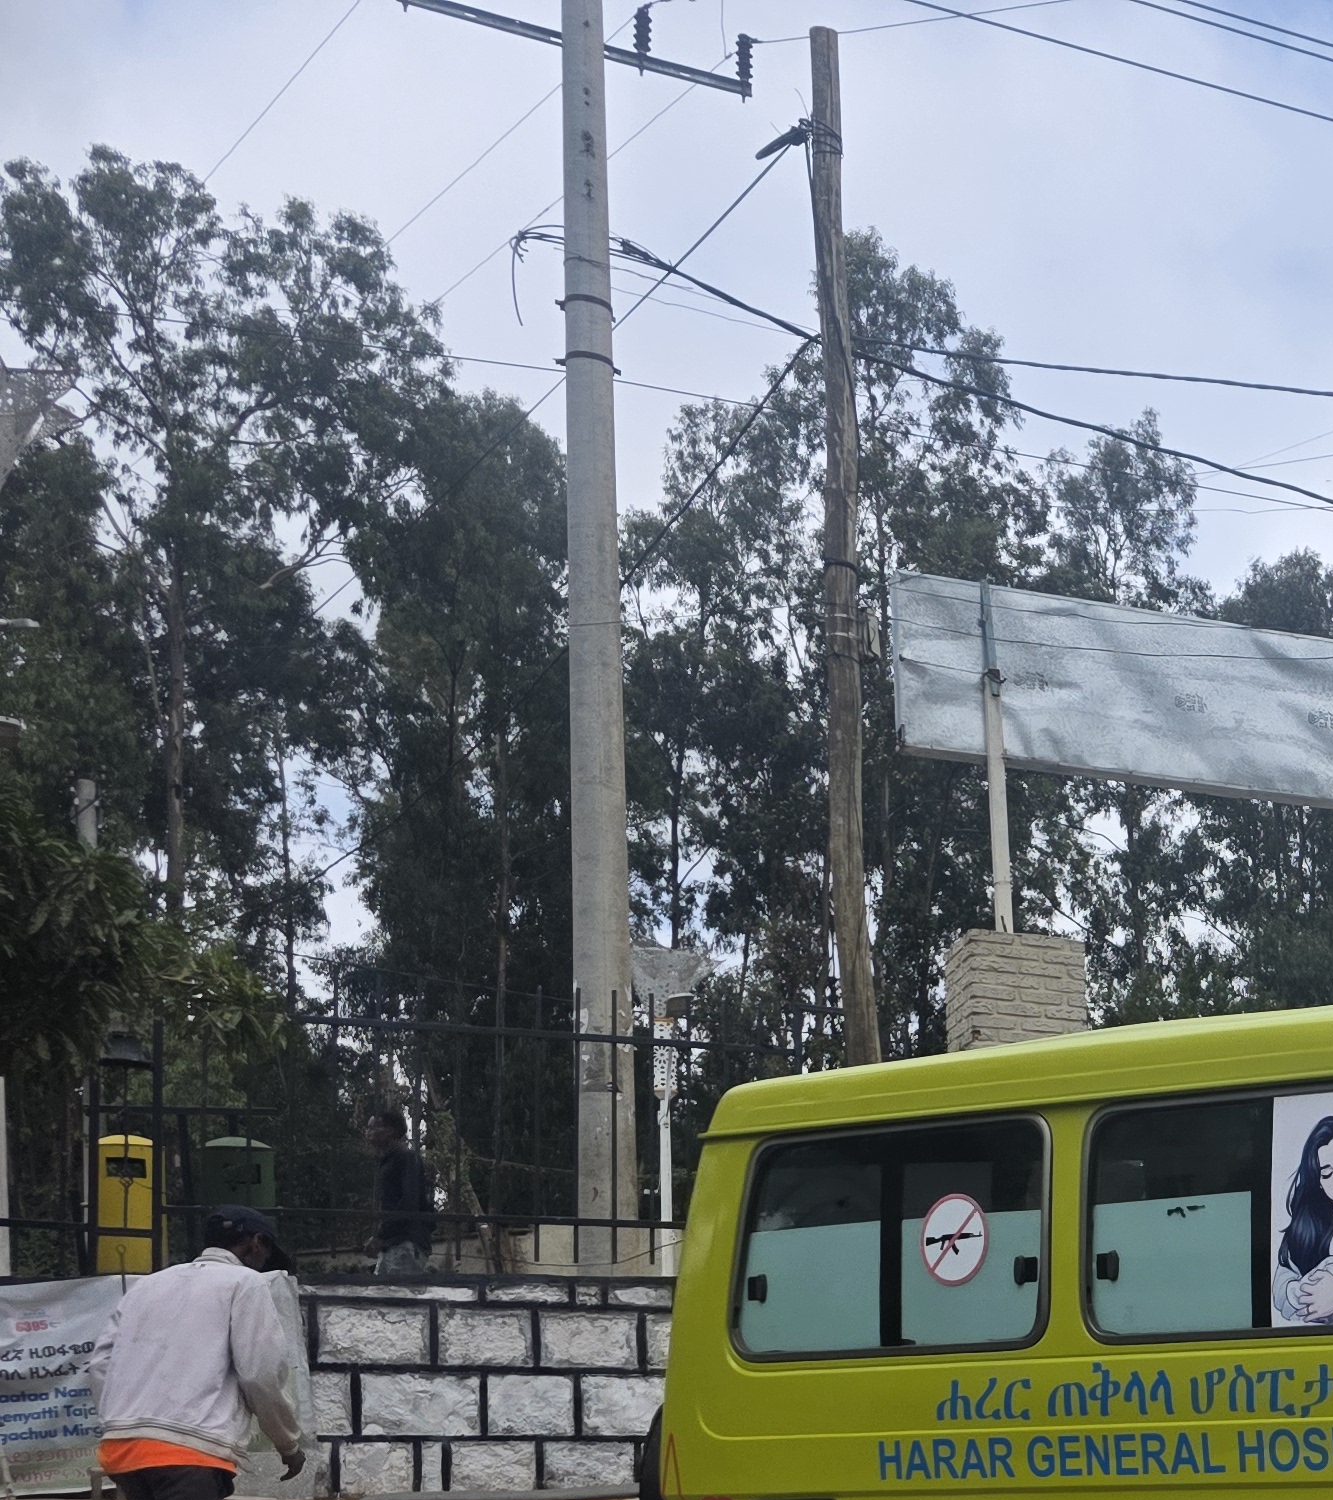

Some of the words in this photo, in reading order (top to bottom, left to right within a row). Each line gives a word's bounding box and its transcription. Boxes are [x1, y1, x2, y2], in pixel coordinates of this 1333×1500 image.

[15, 1319, 48, 1332] 6395
[1047, 1362, 1175, 1417] ጠቅላላ
[878, 1437, 1016, 1481] HARAR
[1027, 1432, 1226, 1478] GENERAL
